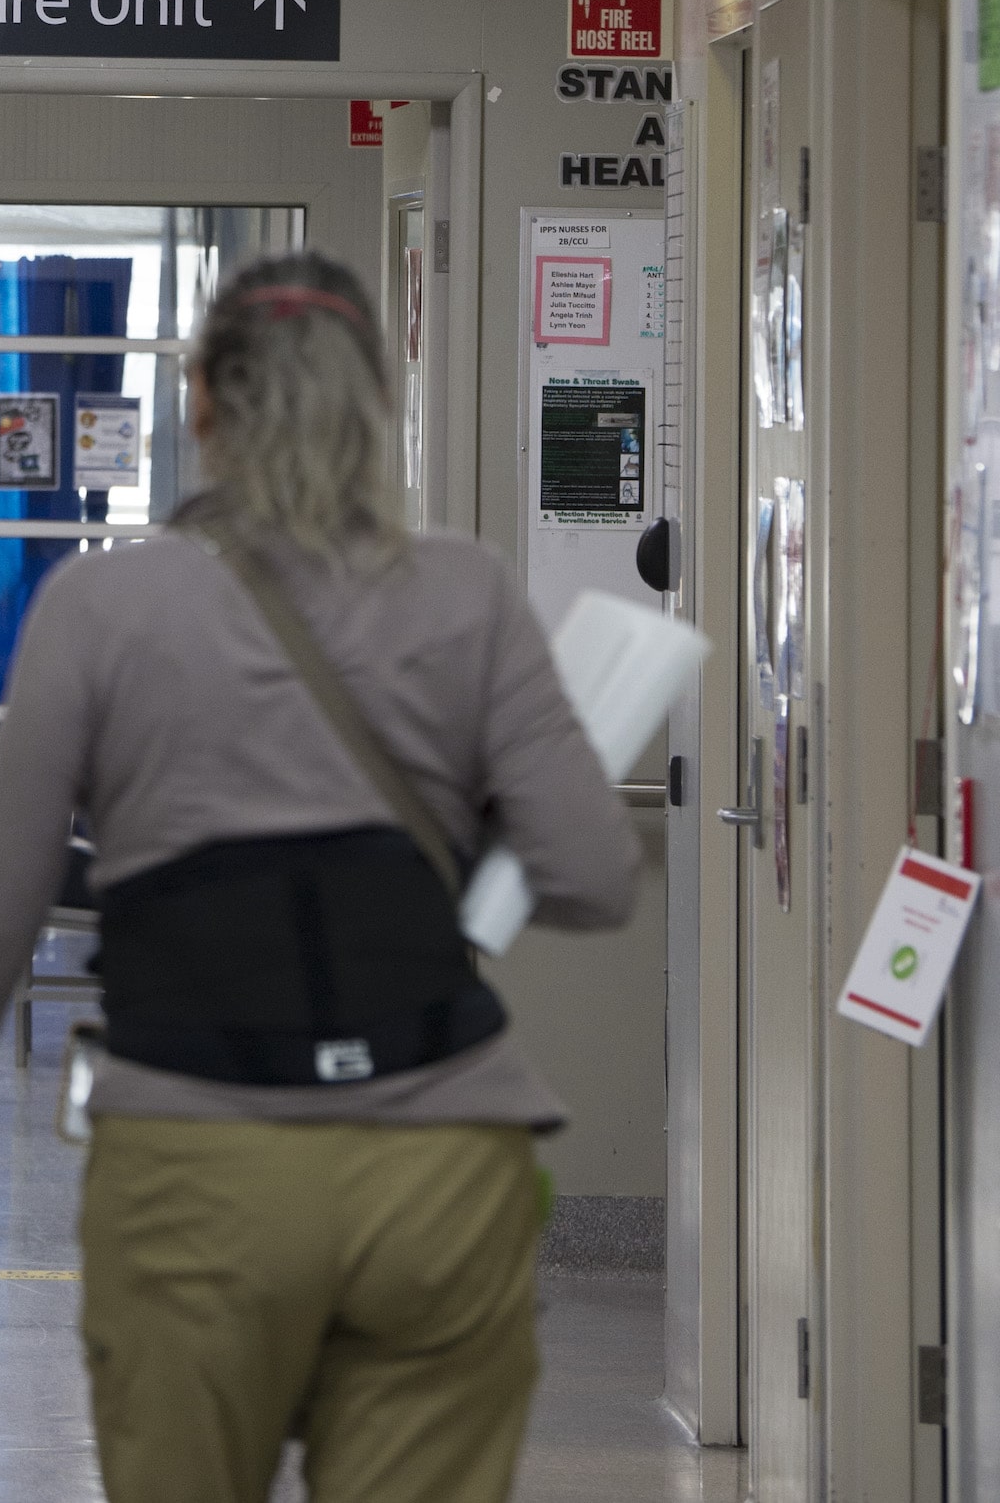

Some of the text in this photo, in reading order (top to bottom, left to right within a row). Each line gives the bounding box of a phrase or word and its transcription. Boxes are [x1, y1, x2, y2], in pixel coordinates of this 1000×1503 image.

[600, 9, 632, 29] FIRE
[576, 30, 656, 51] HOSE REEL
[558, 238, 589, 246] 2B/CCU
